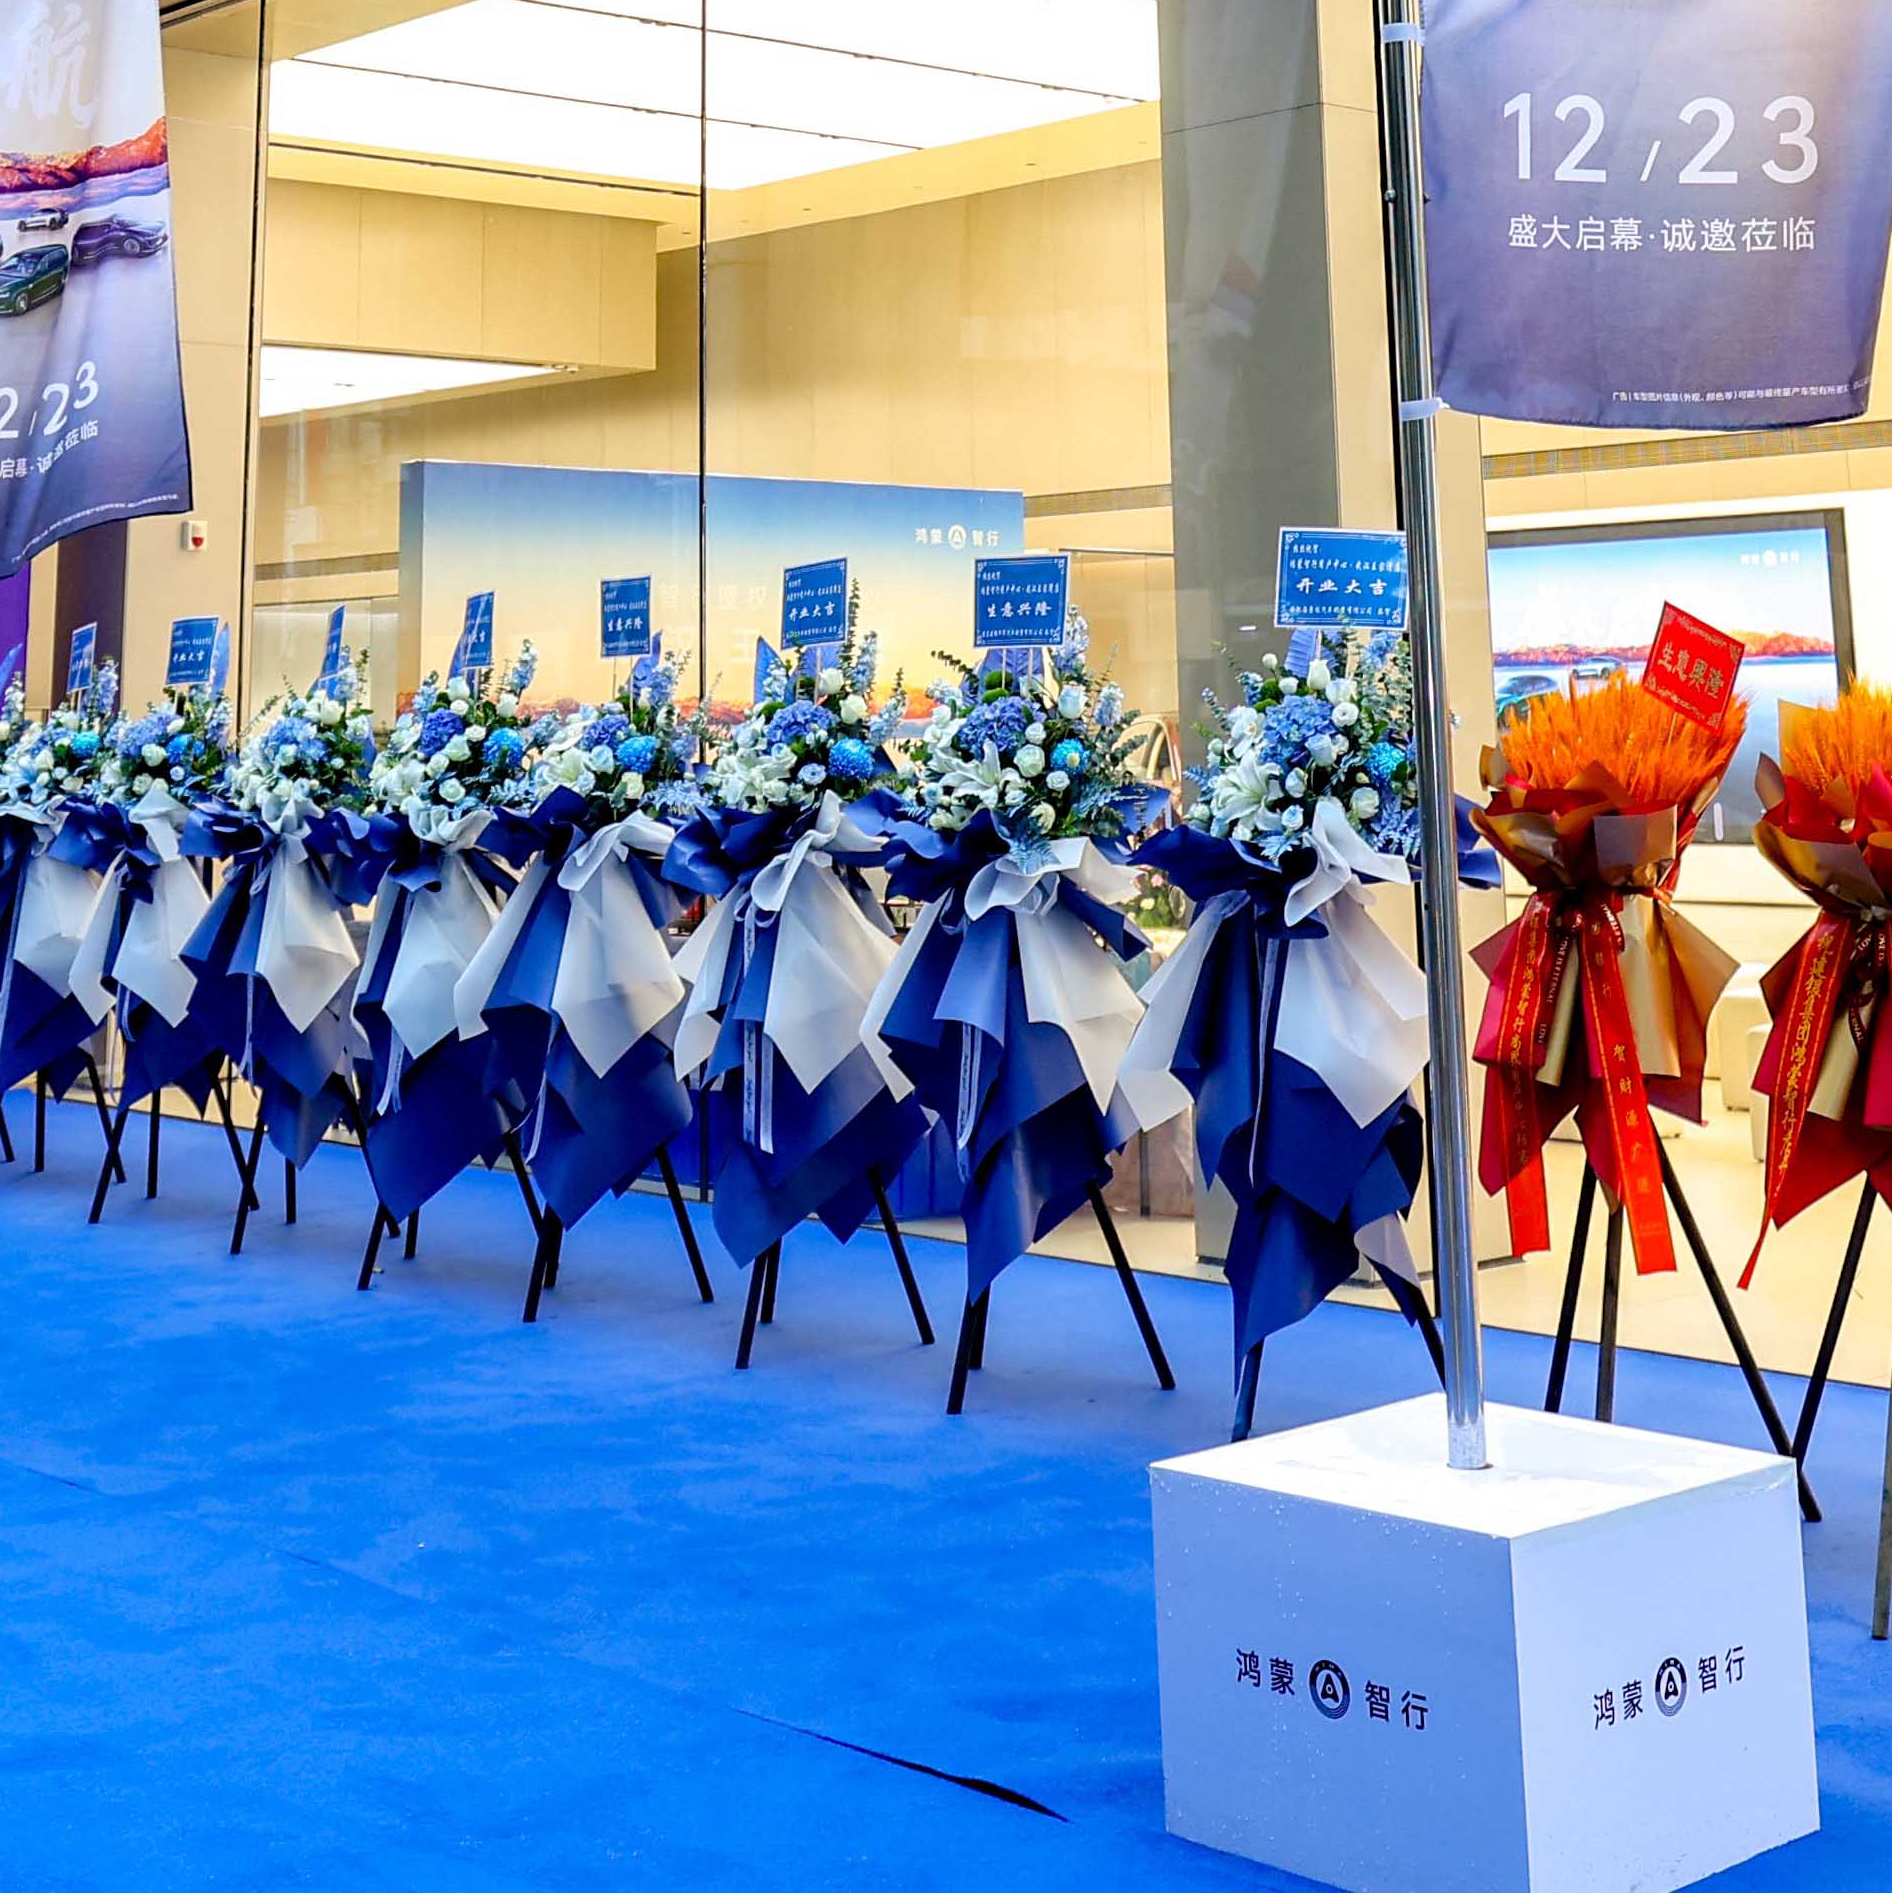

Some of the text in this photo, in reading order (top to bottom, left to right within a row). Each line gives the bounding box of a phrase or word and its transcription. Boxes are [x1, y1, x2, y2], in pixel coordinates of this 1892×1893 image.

[1508, 213, 1816, 253] 盛大启幕·诚邀莅临
[1295, 577, 1388, 596] 开业大吉
[789, 600, 836, 622] 开业大吉
[1235, 1647, 1429, 1731] 鸿蒙 智行
[1593, 1645, 1747, 1729] 鸿蒙 智行
